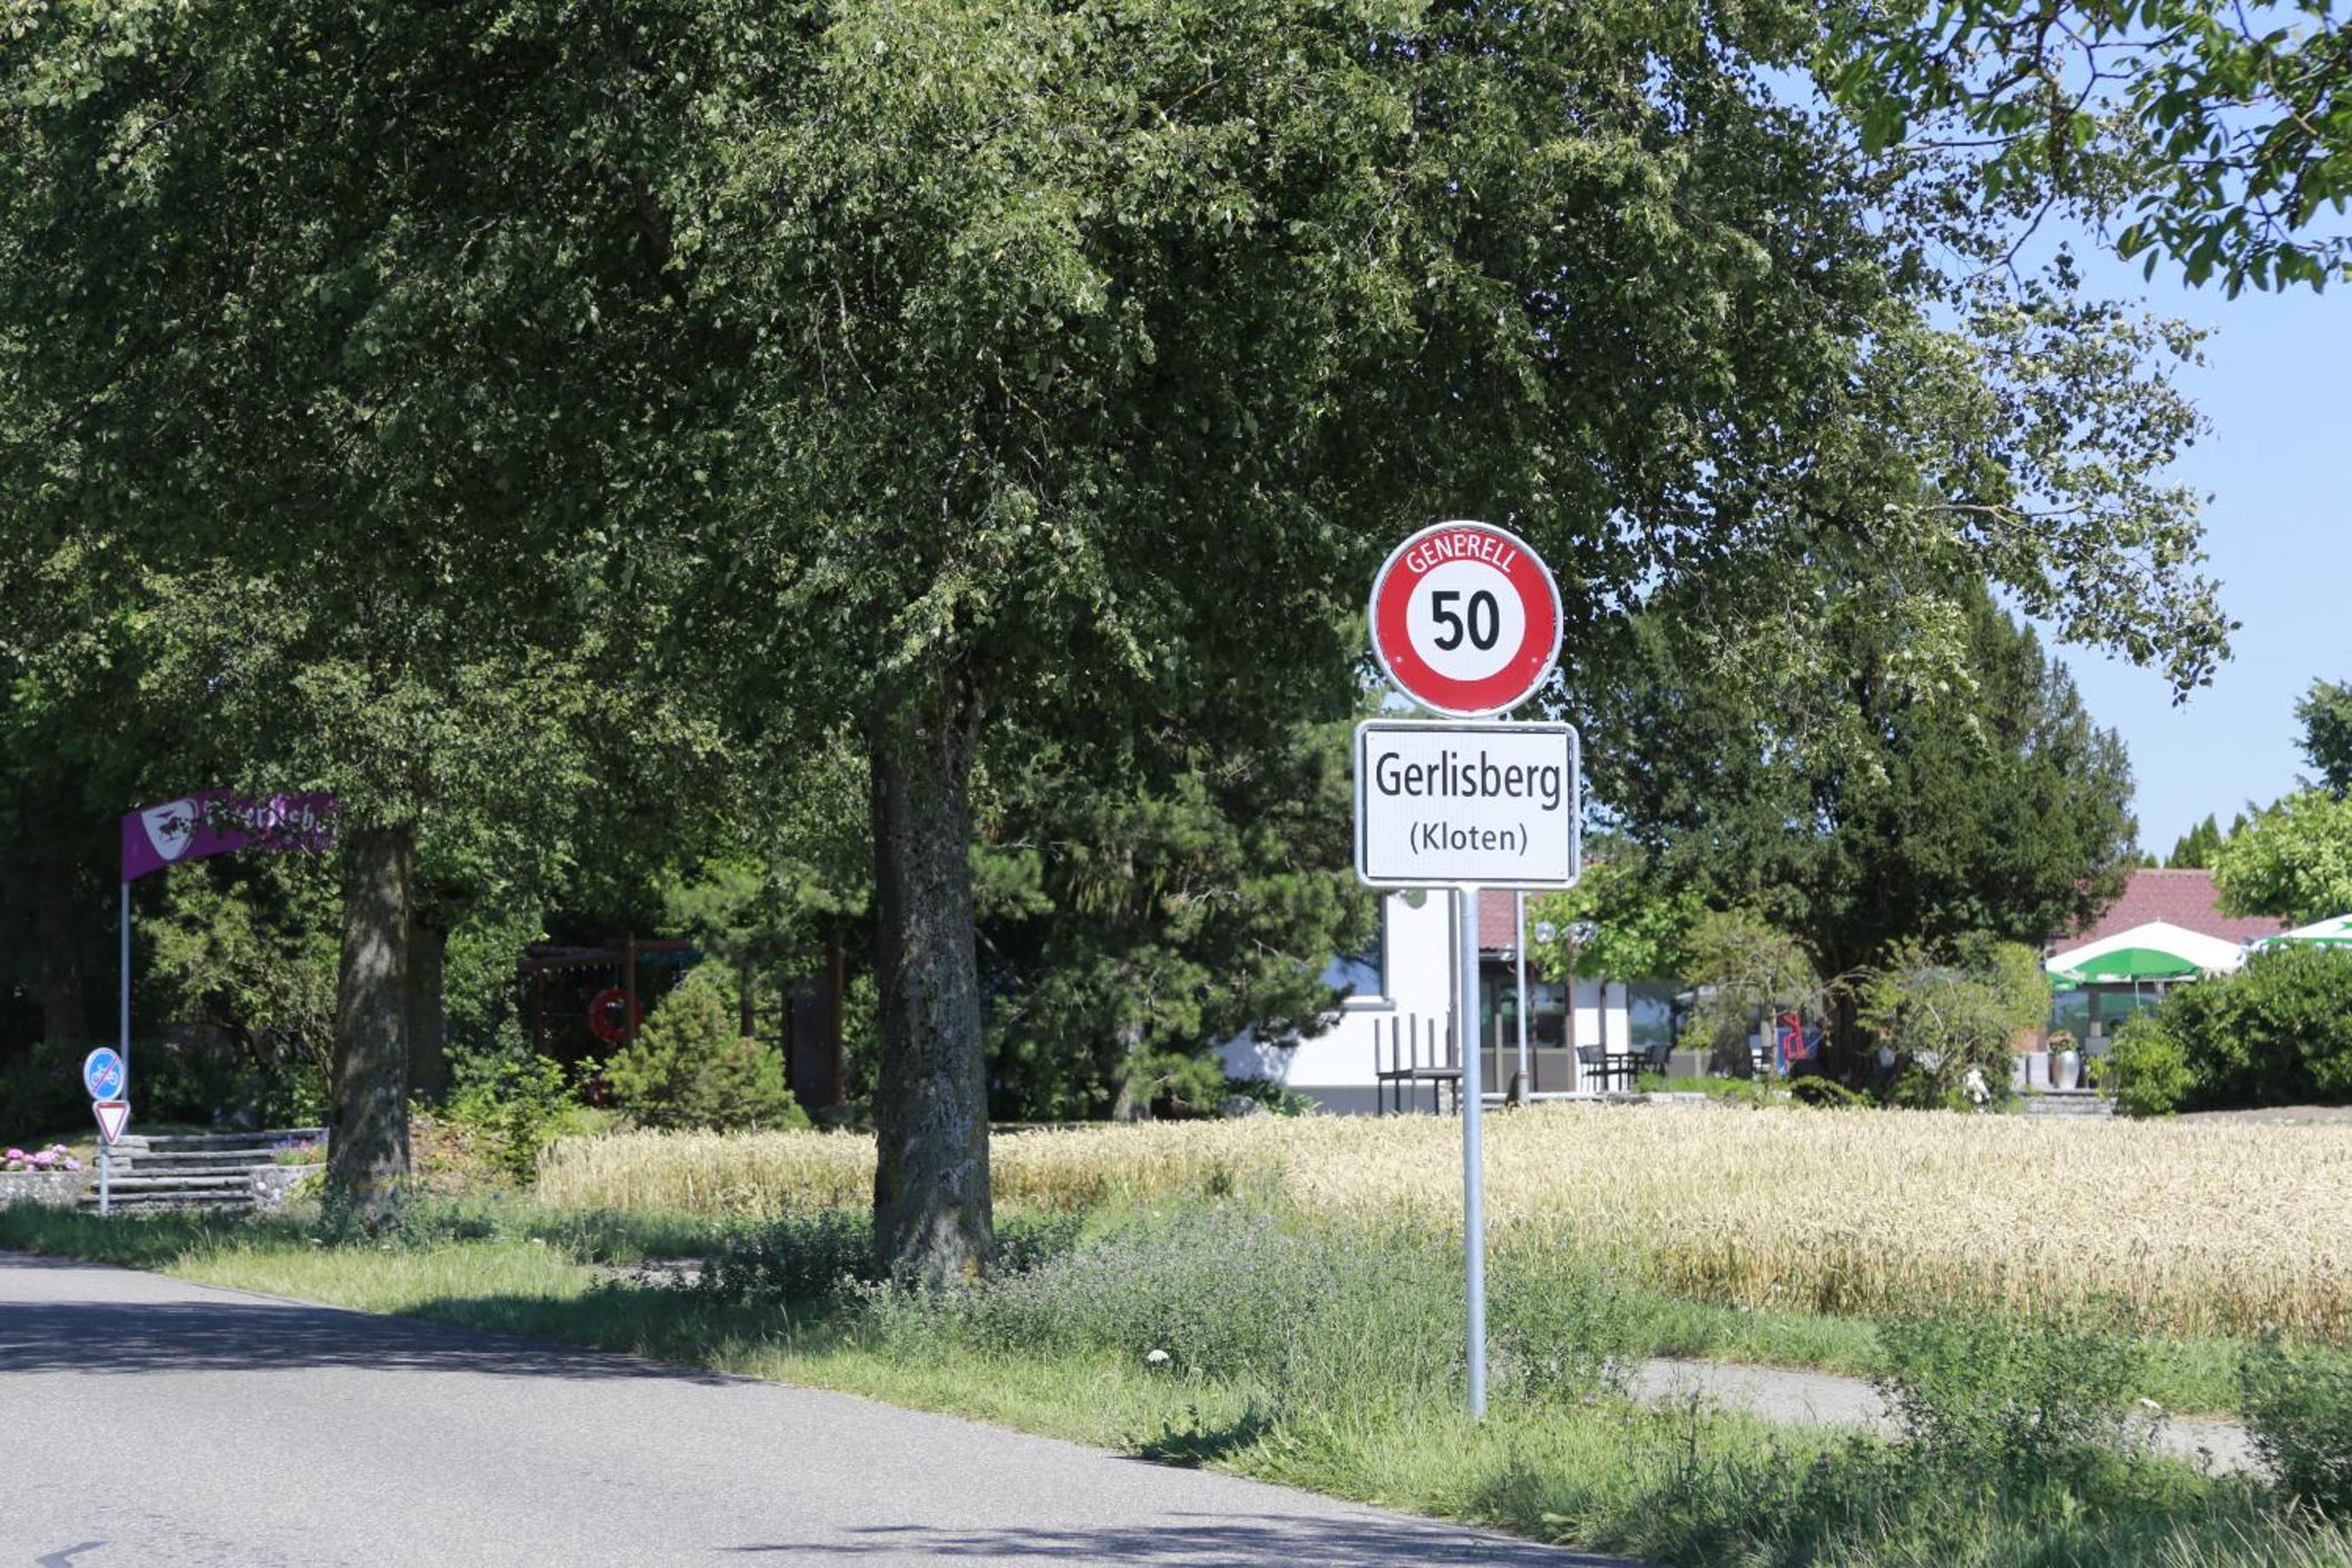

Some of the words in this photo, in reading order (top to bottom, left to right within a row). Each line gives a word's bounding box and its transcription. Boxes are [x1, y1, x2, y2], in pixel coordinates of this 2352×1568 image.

[1406, 533, 1517, 573] GENERELL
[1432, 591, 1499, 651] 50
[1376, 751, 1561, 811] Gerlisberg
[1411, 822, 1528, 855] (Kloten)
